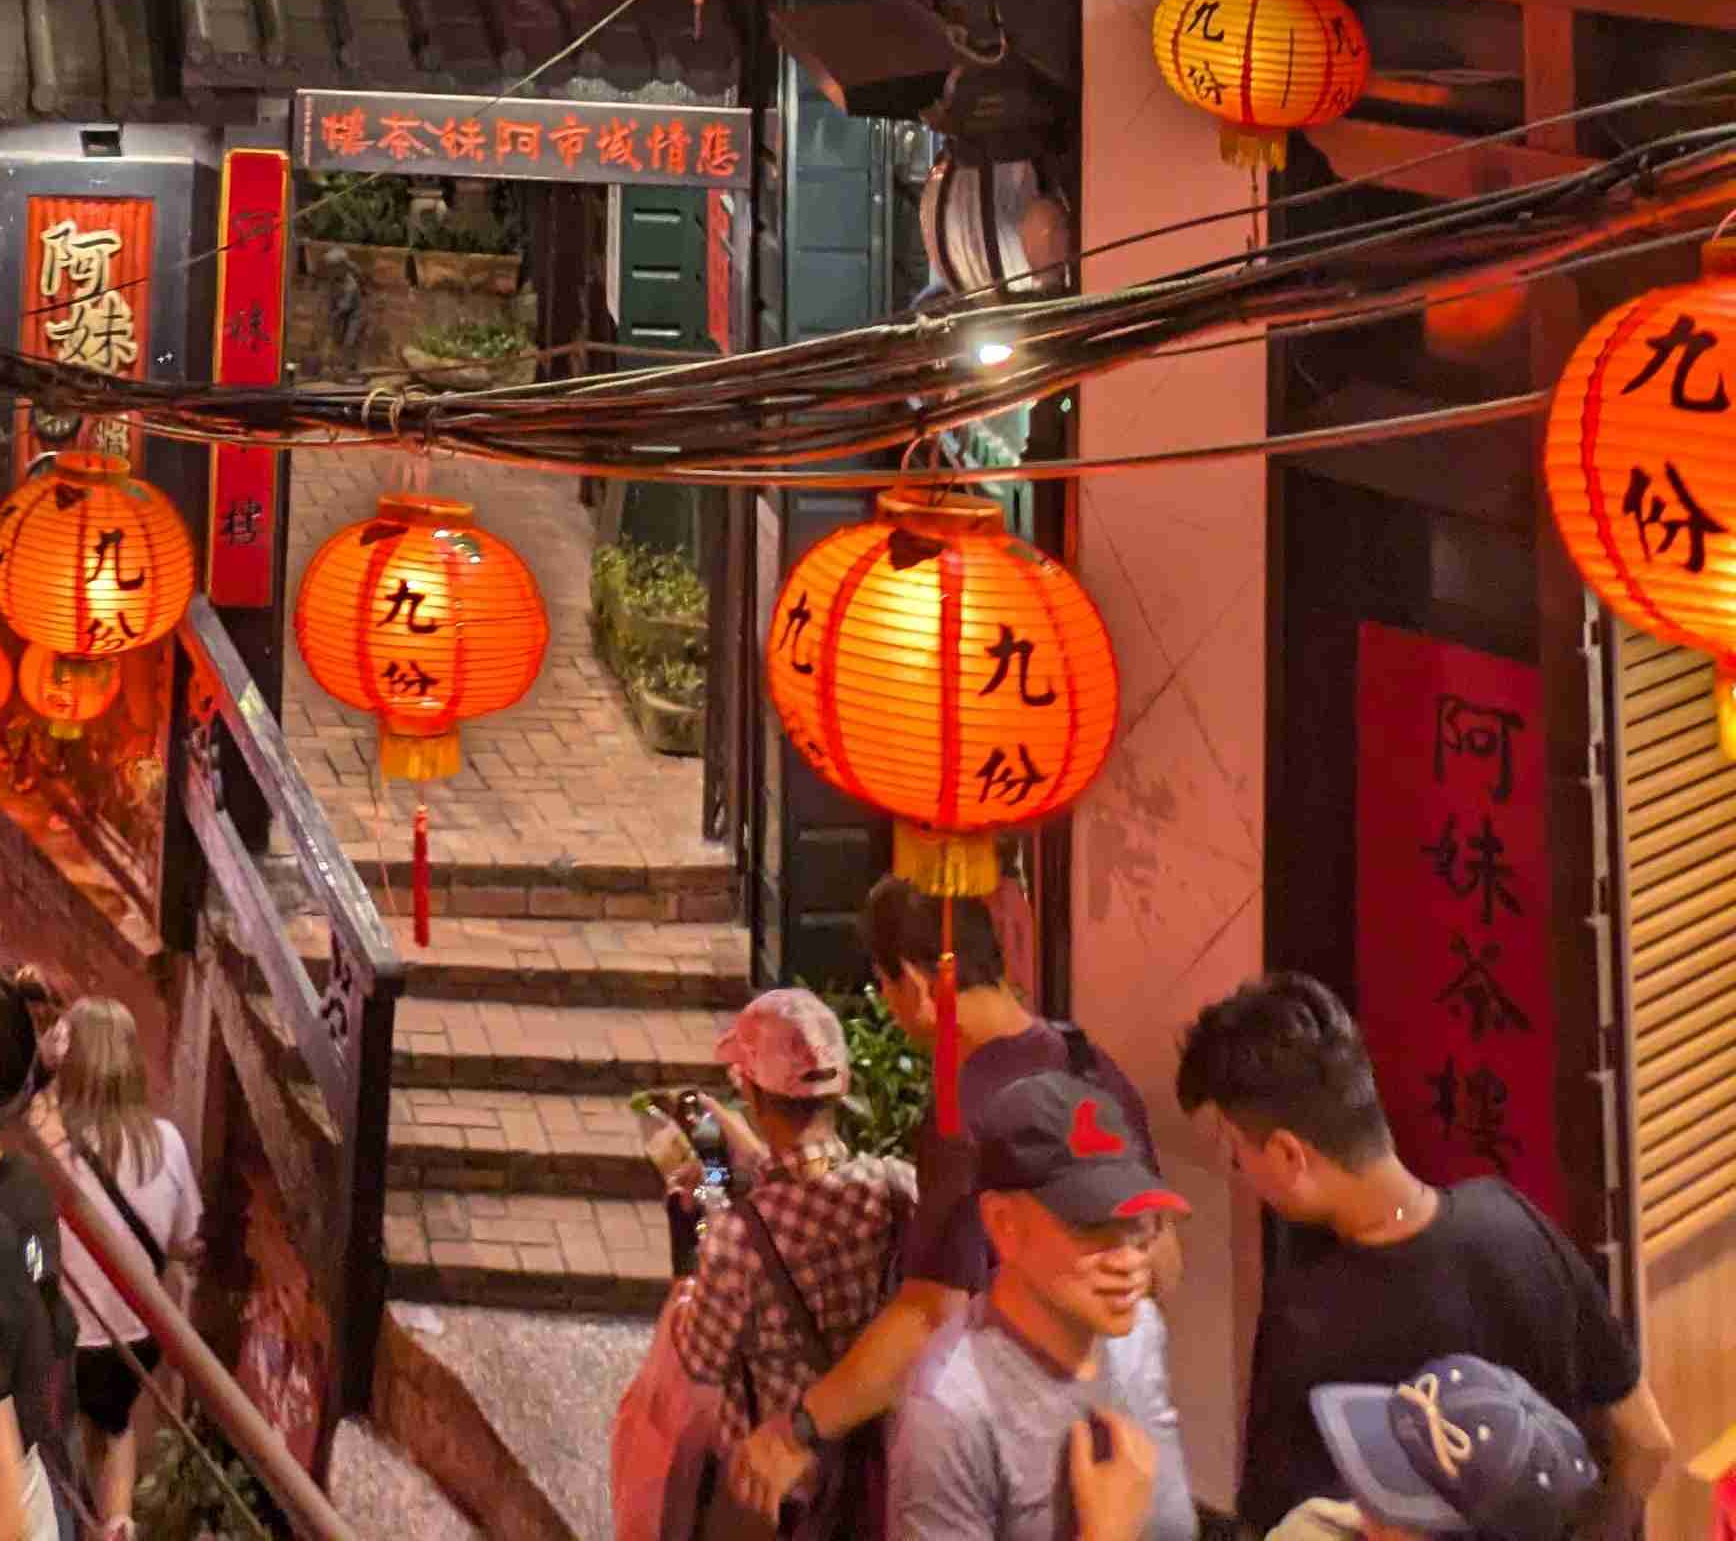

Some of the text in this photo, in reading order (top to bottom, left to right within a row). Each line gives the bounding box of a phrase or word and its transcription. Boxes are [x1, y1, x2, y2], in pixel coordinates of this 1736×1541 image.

[1186, 0, 1228, 106] 九份
[1619, 313, 1732, 575] 九份
[84, 528, 147, 656] 九份
[376, 577, 441, 697] 九份
[977, 622, 1058, 806] 九份
